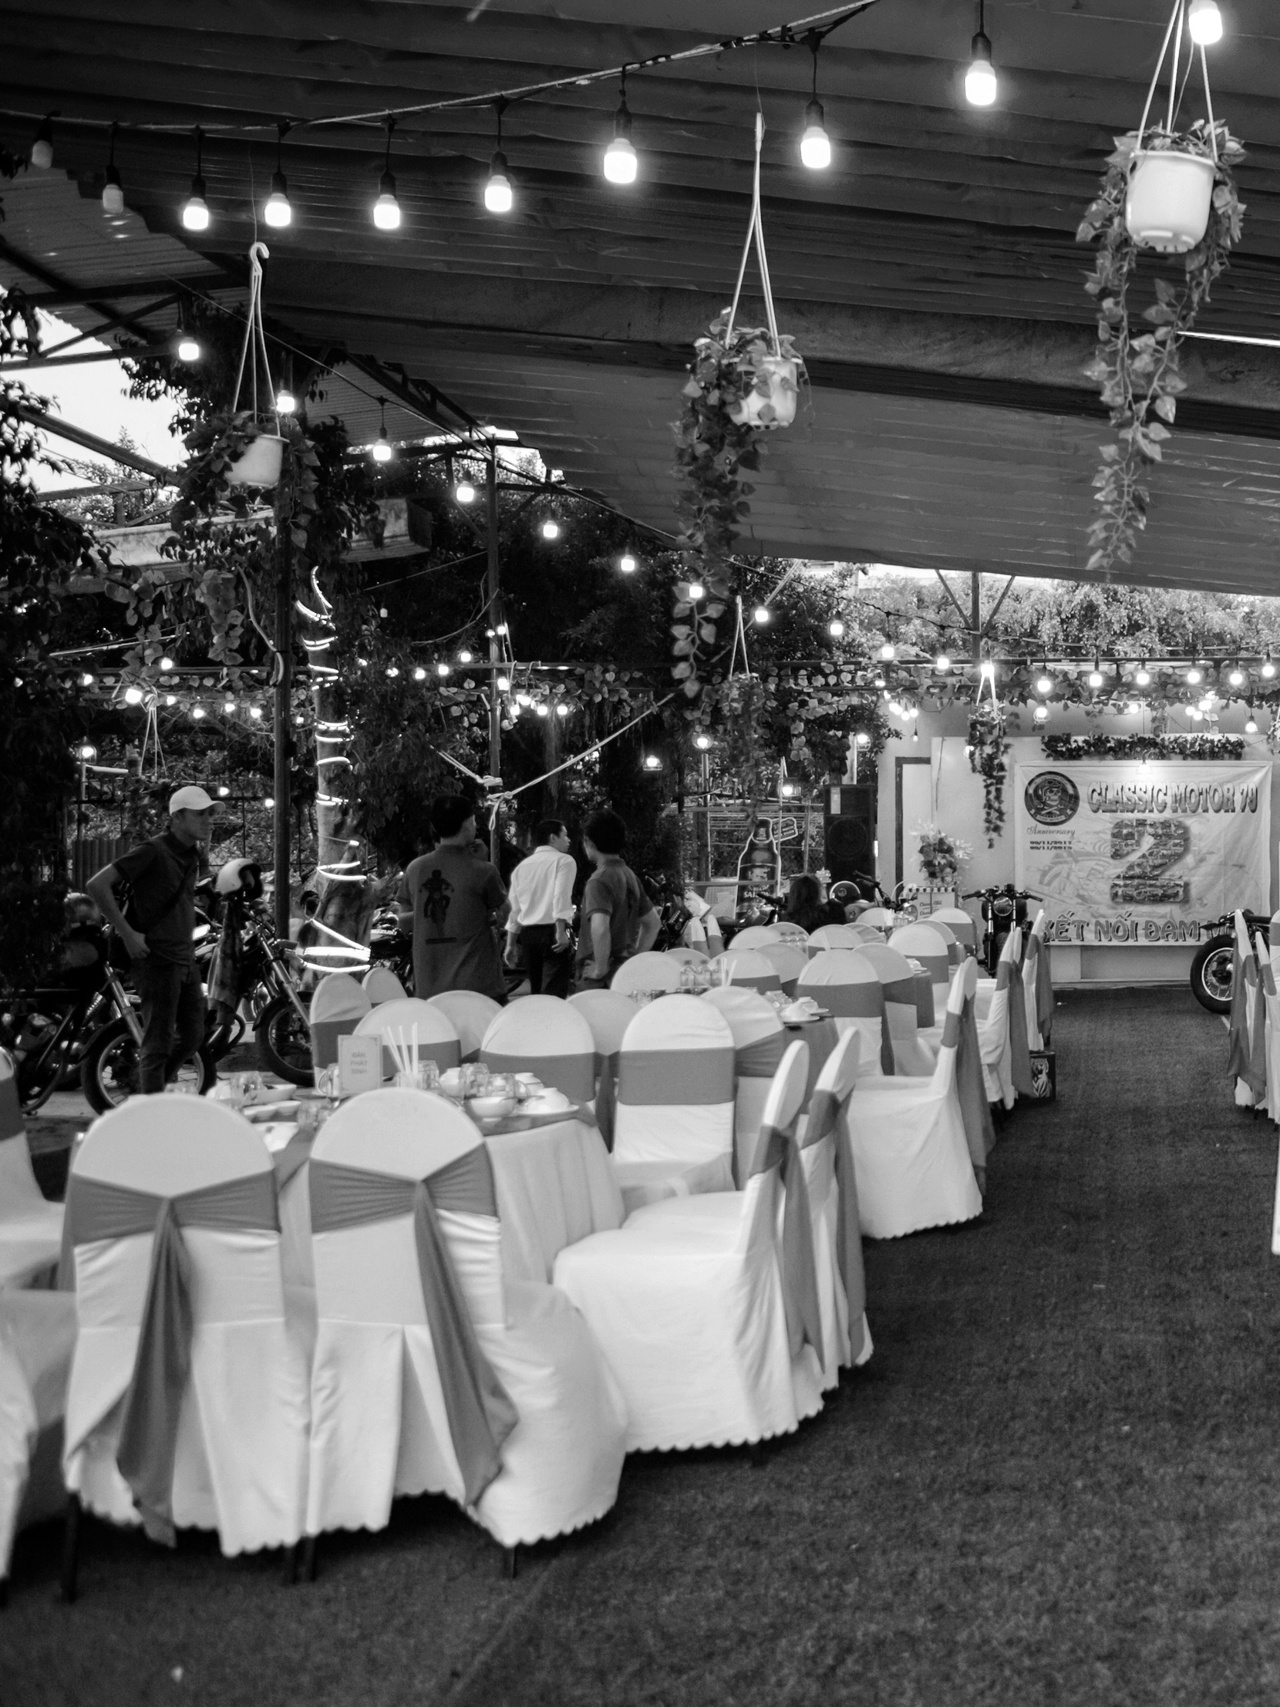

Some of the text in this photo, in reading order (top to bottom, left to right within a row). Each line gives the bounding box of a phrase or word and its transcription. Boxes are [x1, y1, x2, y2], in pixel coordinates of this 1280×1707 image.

[1087, 781, 1168, 814] CLASSIC
[1170, 781, 1236, 814] MOTOR
[1239, 782, 1258, 814] 79
[1026, 823, 1076, 840] Anniversary
[1043, 910, 1088, 942] KẾT
[1094, 910, 1139, 942] NỐI
[1143, 919, 1200, 942] ĐAM
